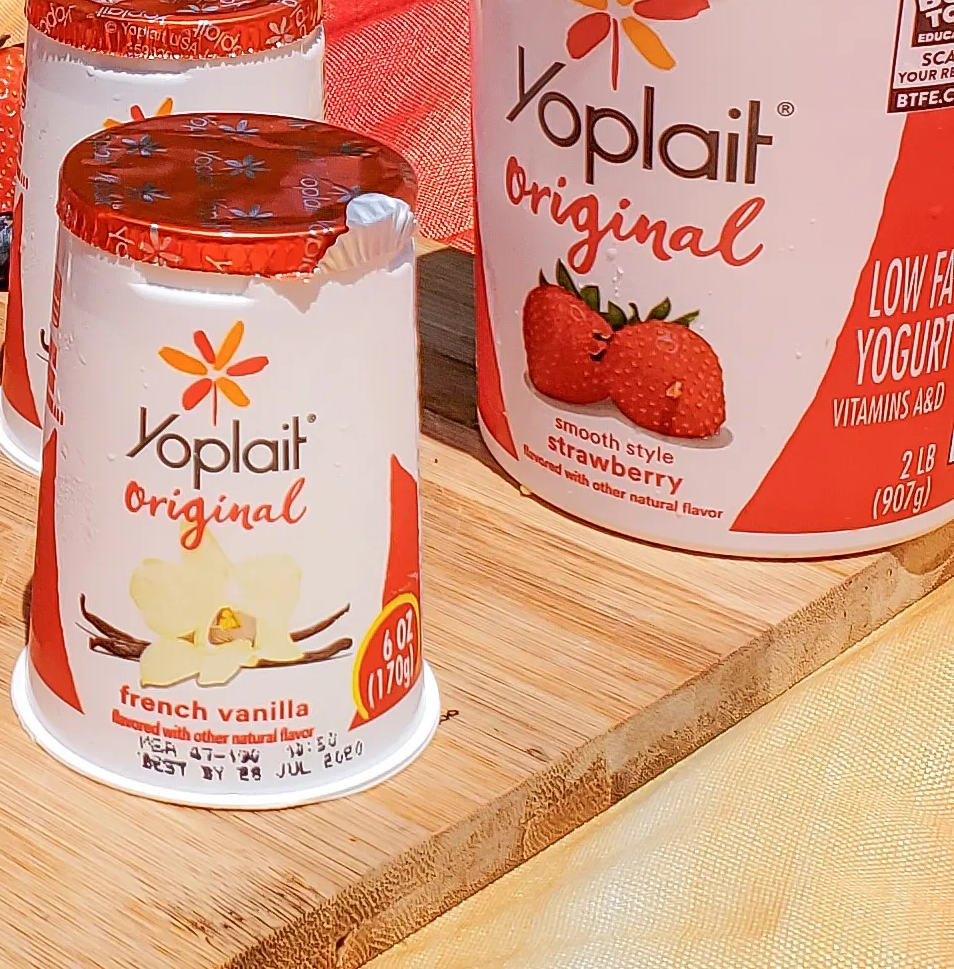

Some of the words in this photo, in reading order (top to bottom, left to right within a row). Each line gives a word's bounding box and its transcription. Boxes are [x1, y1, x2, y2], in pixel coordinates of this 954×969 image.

[917, 30, 954, 44] EDUC
[925, 8, 954, 28] TO
[898, 69, 936, 84] YOUR
[940, 67, 954, 80] RE
[922, 50, 954, 67] SCA
[896, 88, 954, 109] BTFE.C
[868, 254, 929, 319] LOW
[930, 249, 954, 309] FA
[856, 313, 954, 386] YOGURT
[833, 390, 910, 428] VITAMINS
[912, 382, 945, 415] A&D
[555, 416, 621, 452] smooth
[626, 440, 675, 465] style
[899, 450, 914, 480] 2
[916, 443, 937, 476] LB
[523, 444, 562, 476] flavored
[564, 469, 590, 488] with
[592, 480, 626, 500] other
[629, 492, 678, 513] natural
[682, 502, 724, 520] flavor
[547, 433, 683, 495] strawberry
[872, 476, 931, 520] (907g)
[382, 636, 393, 659] 6
[397, 611, 414, 653] OZ
[367, 651, 416, 709] (170g)
[119, 685, 209, 722] french
[217, 698, 310, 723] vanilla
[111, 708, 161, 737] flavored
[162, 724, 191, 742] with
[193, 729, 230, 744] other
[232, 728, 277, 745] natural
[279, 726, 314, 741] flavor
[142, 753, 187, 777] BEST
[201, 765, 224, 781] BY
[275, 761, 312, 779] JUL
[323, 740, 363, 769] 2020
